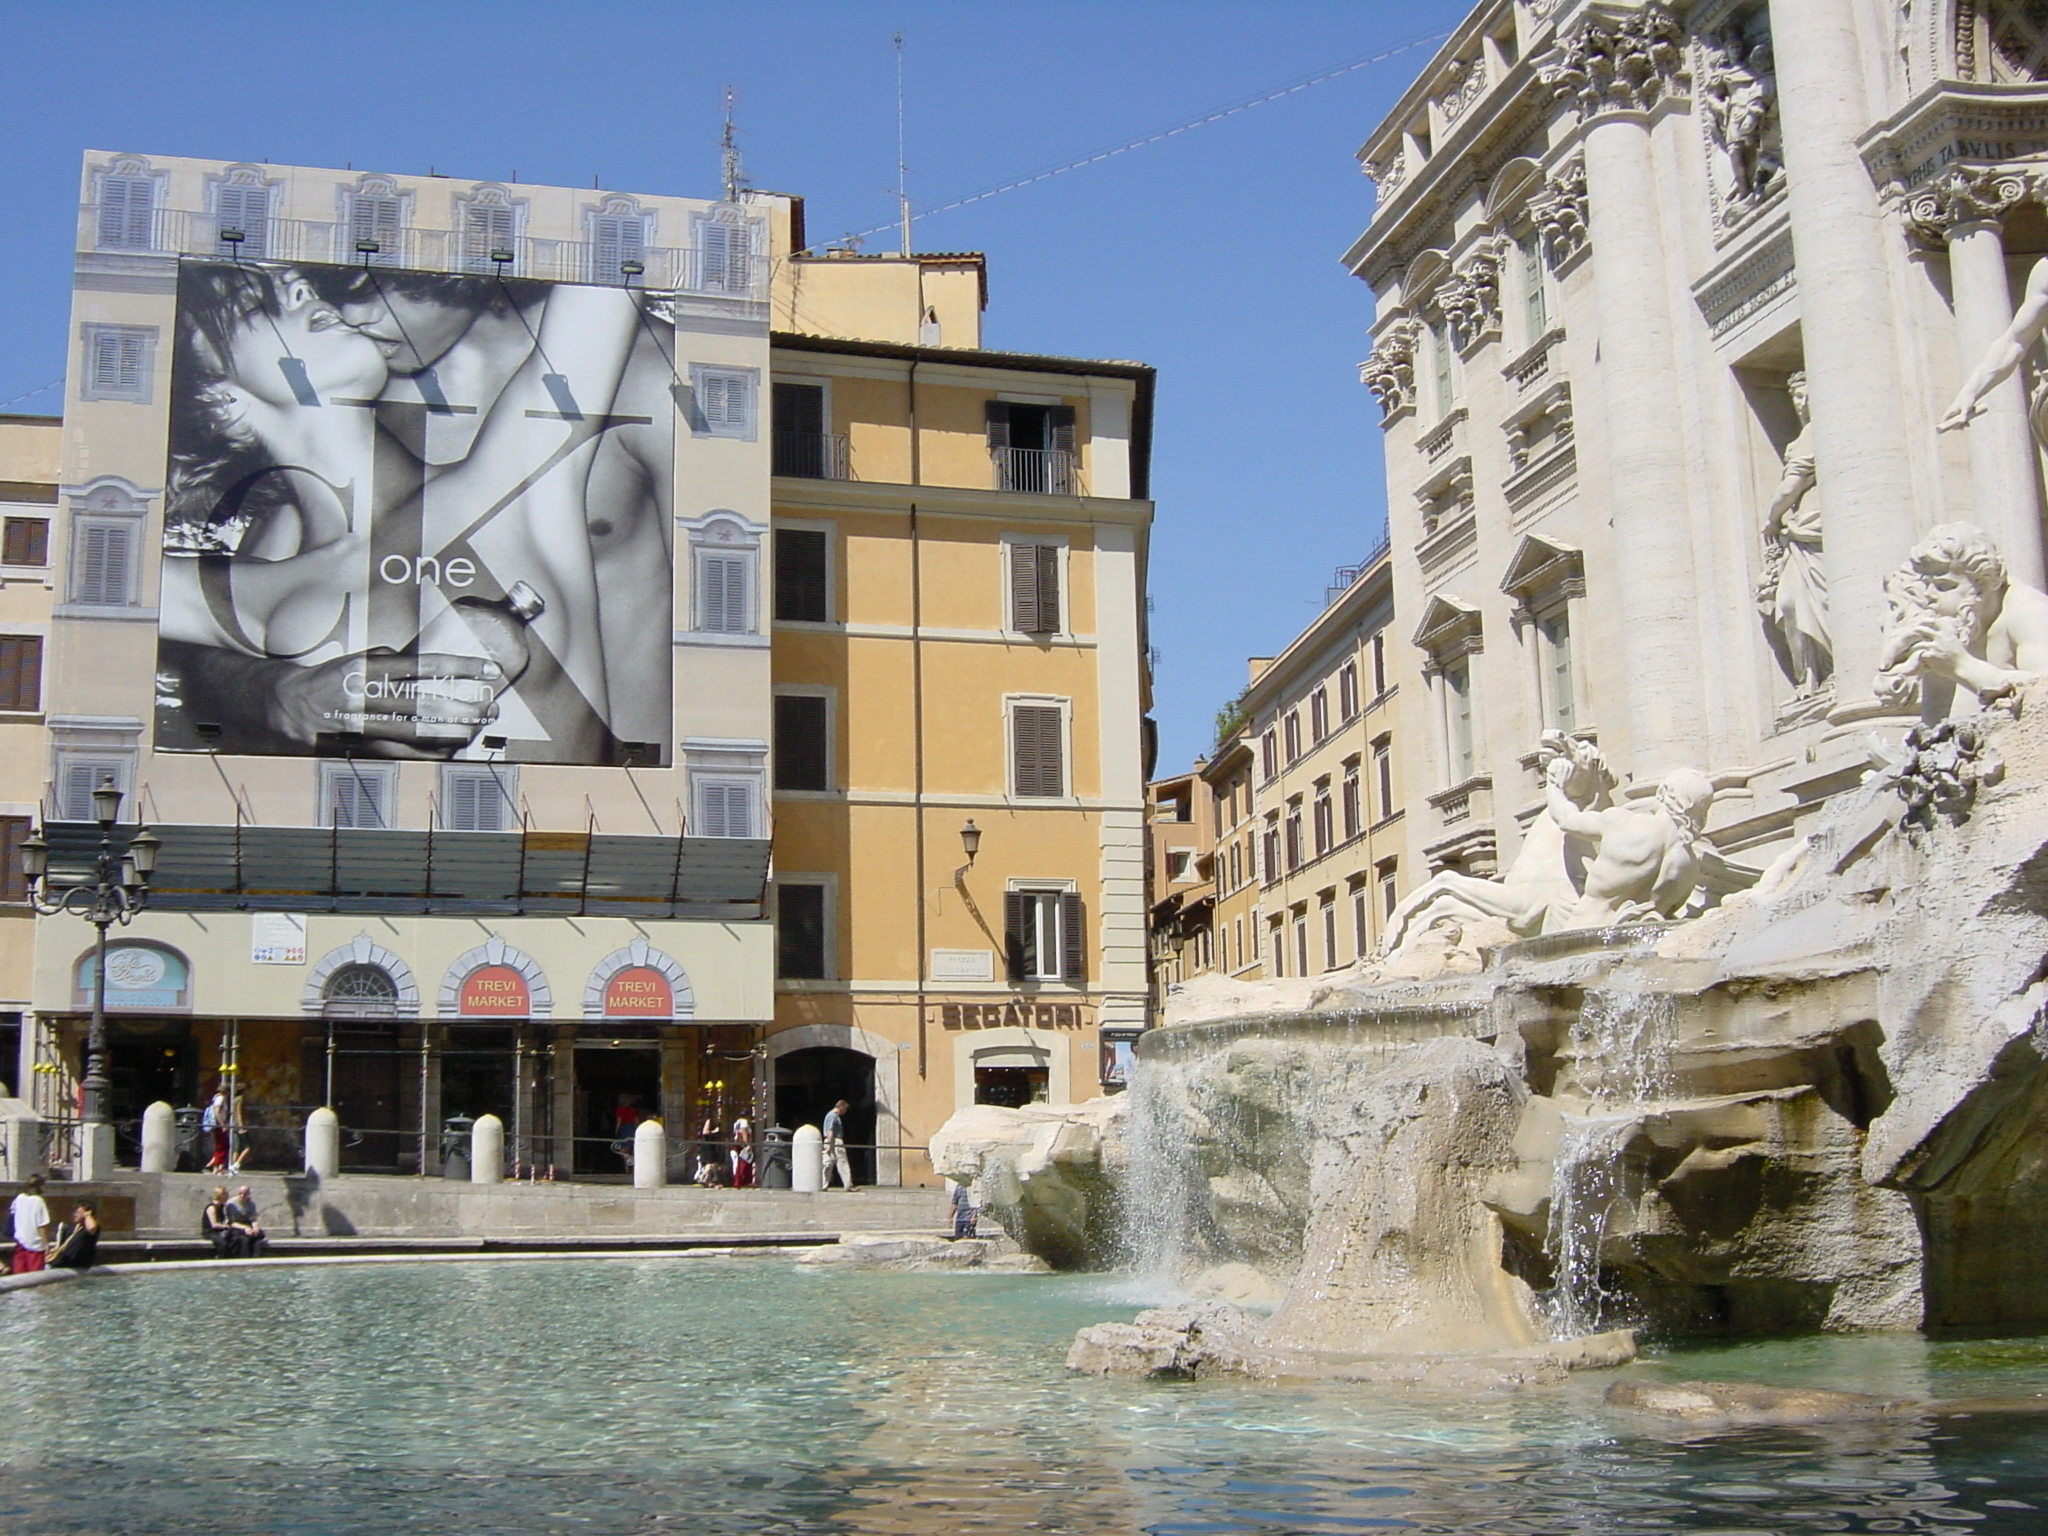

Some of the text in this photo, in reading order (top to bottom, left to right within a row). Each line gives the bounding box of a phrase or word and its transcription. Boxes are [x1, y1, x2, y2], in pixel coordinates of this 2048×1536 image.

[379, 553, 477, 588] one
[343, 671, 494, 702] Calvin Klein
[323, 711, 331, 720] a
[334, 709, 388, 722] fragrance
[392, 711, 407, 722] for
[421, 715, 444, 723] man
[462, 716, 469, 724] a
[476, 980, 516, 992] TREVI
[617, 981, 656, 993] TREVI
[468, 995, 525, 1007] MARKET
[609, 996, 664, 1008] MARKET
